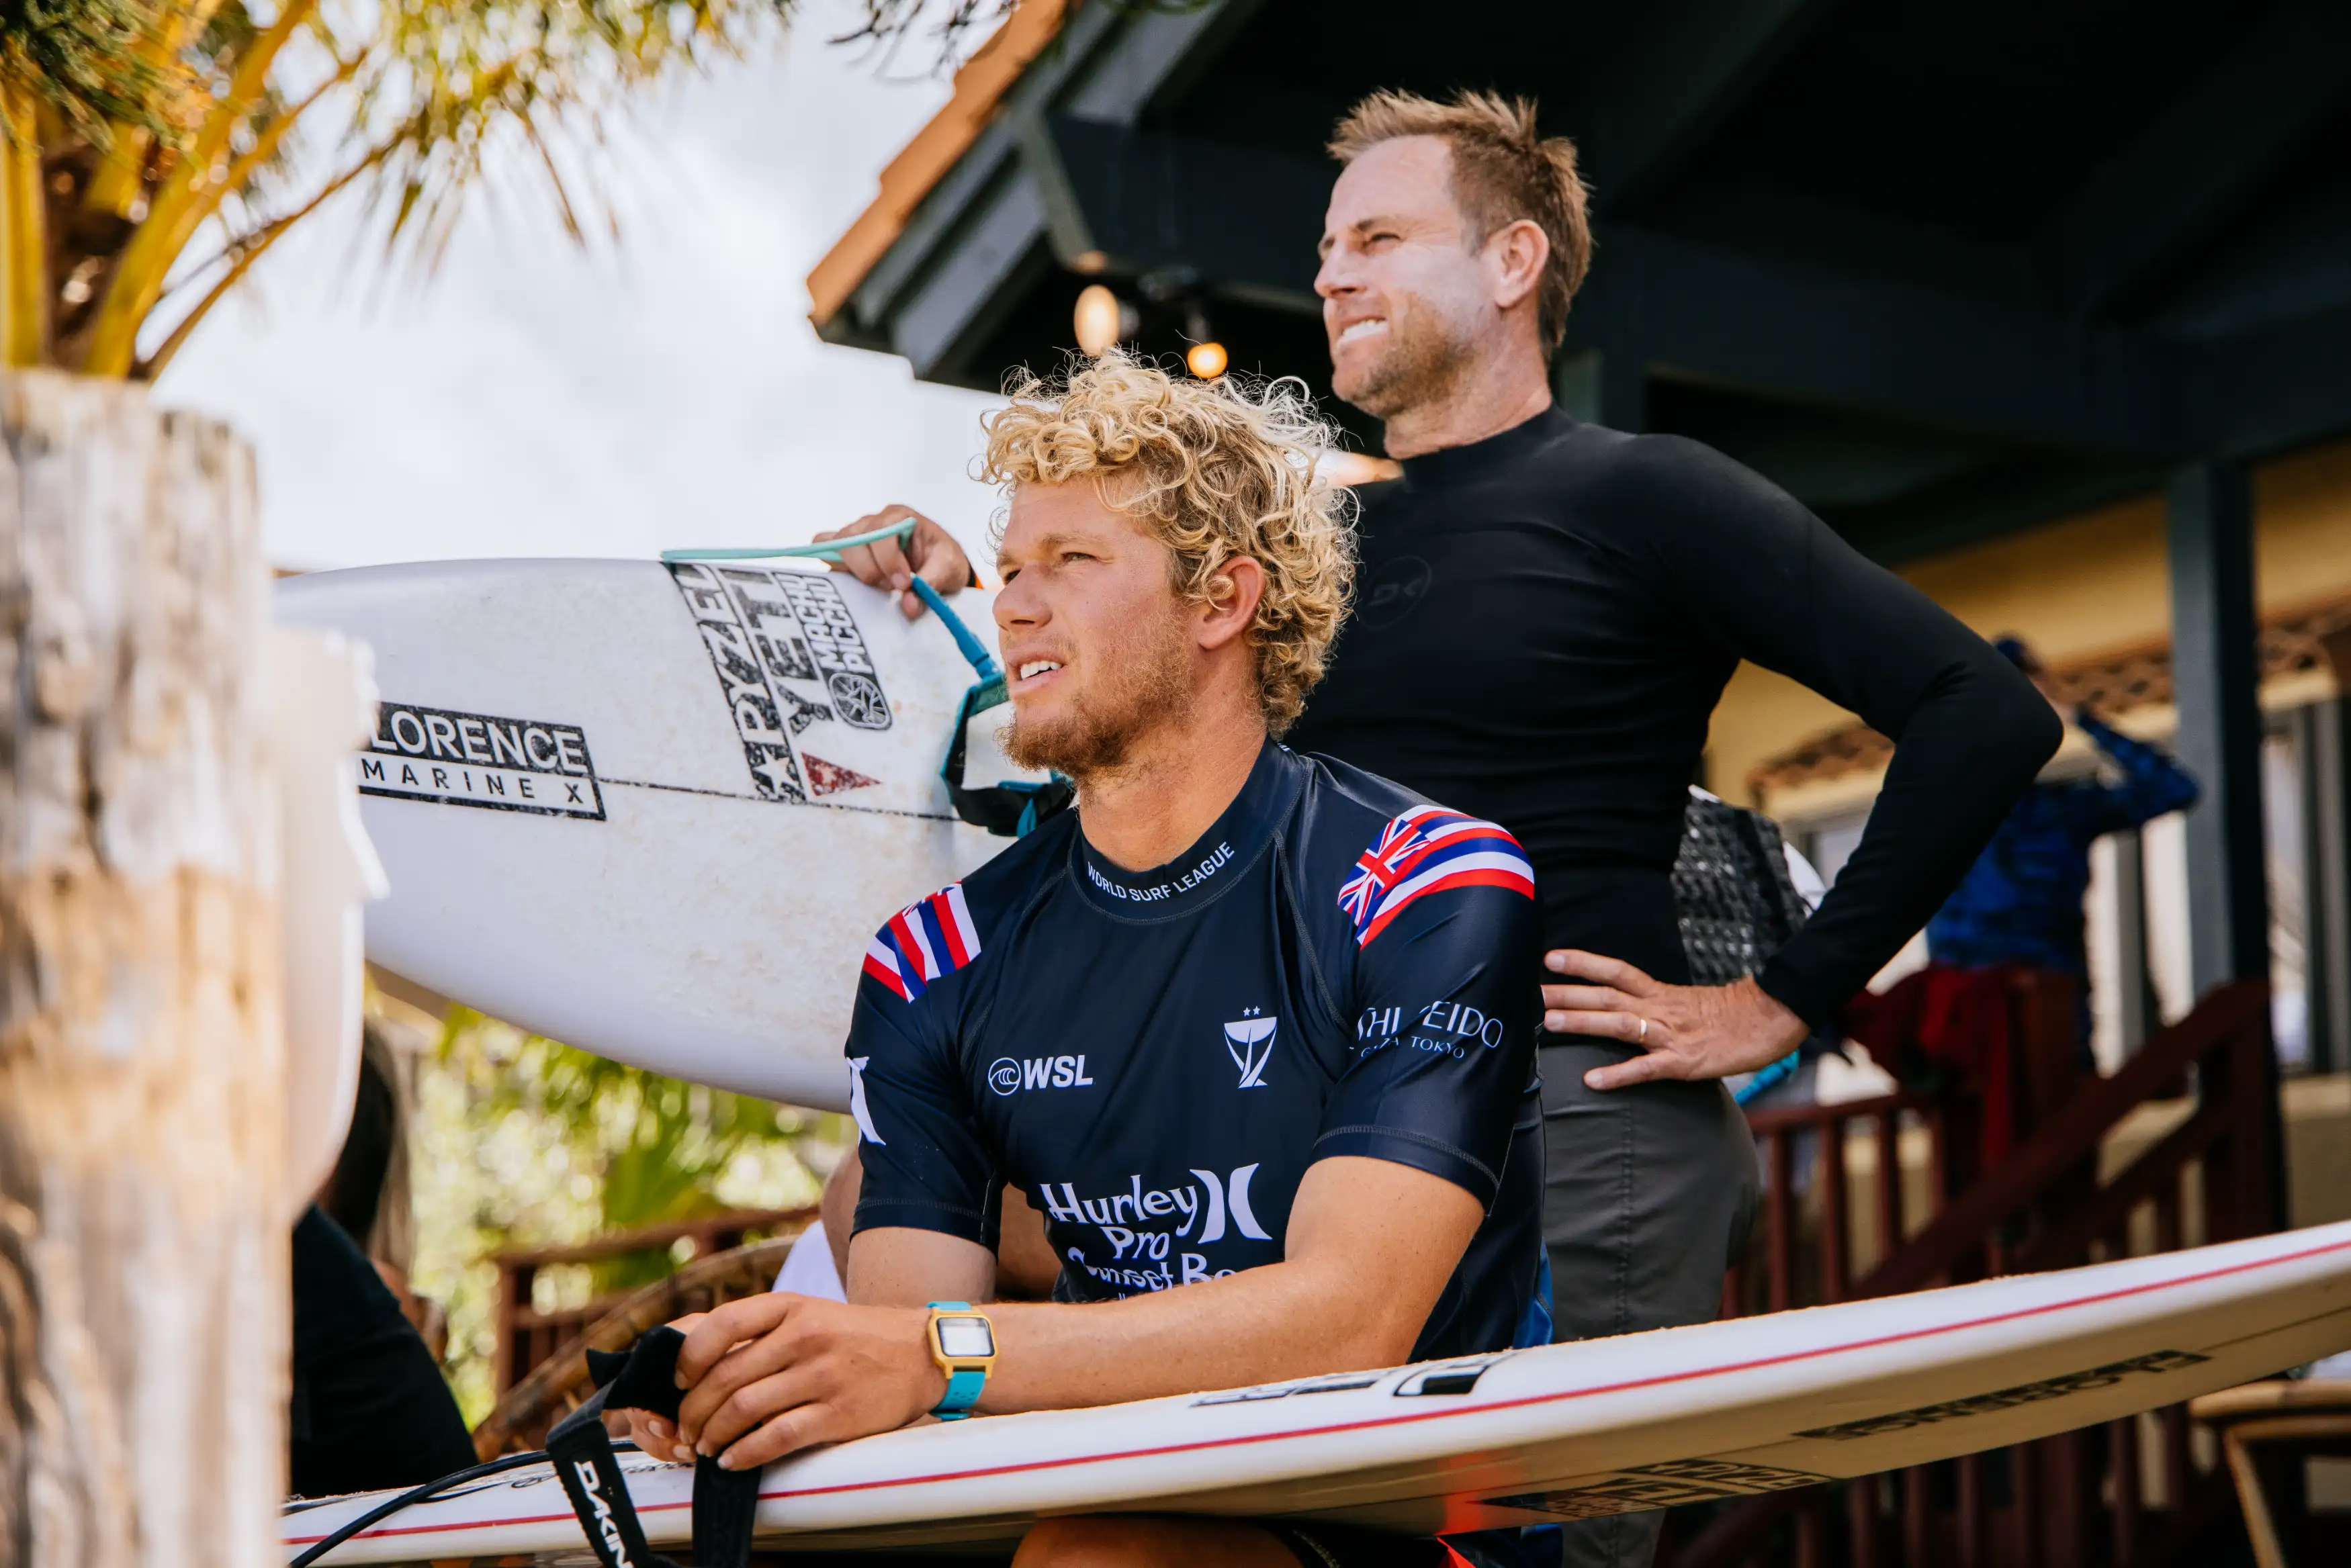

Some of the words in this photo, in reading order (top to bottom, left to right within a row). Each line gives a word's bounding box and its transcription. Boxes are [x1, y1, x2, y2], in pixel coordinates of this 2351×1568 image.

[717, 569, 834, 737] YETI
[776, 573, 846, 671] MACHU
[803, 576, 873, 673] PICCHU
[674, 565, 787, 745] PYZEL
[371, 710, 589, 774] LORENCE
[361, 757, 535, 799] MARINE
[564, 782, 584, 804] X
[1088, 861, 1127, 899] WORLD
[1128, 884, 1171, 902] SURF
[1172, 841, 1235, 893] LEAGUE
[1357, 1001, 1503, 1048] SHIEIDO
[1411, 1036, 1465, 1058] TOKYO
[1023, 1054, 1094, 1090] WSL
[1039, 1174, 1198, 1237] Hurley
[1067, 1246, 1174, 1291] Sunset
[1100, 1226, 1170, 1260] Pro
[573, 1460, 634, 1568] DAKIN
